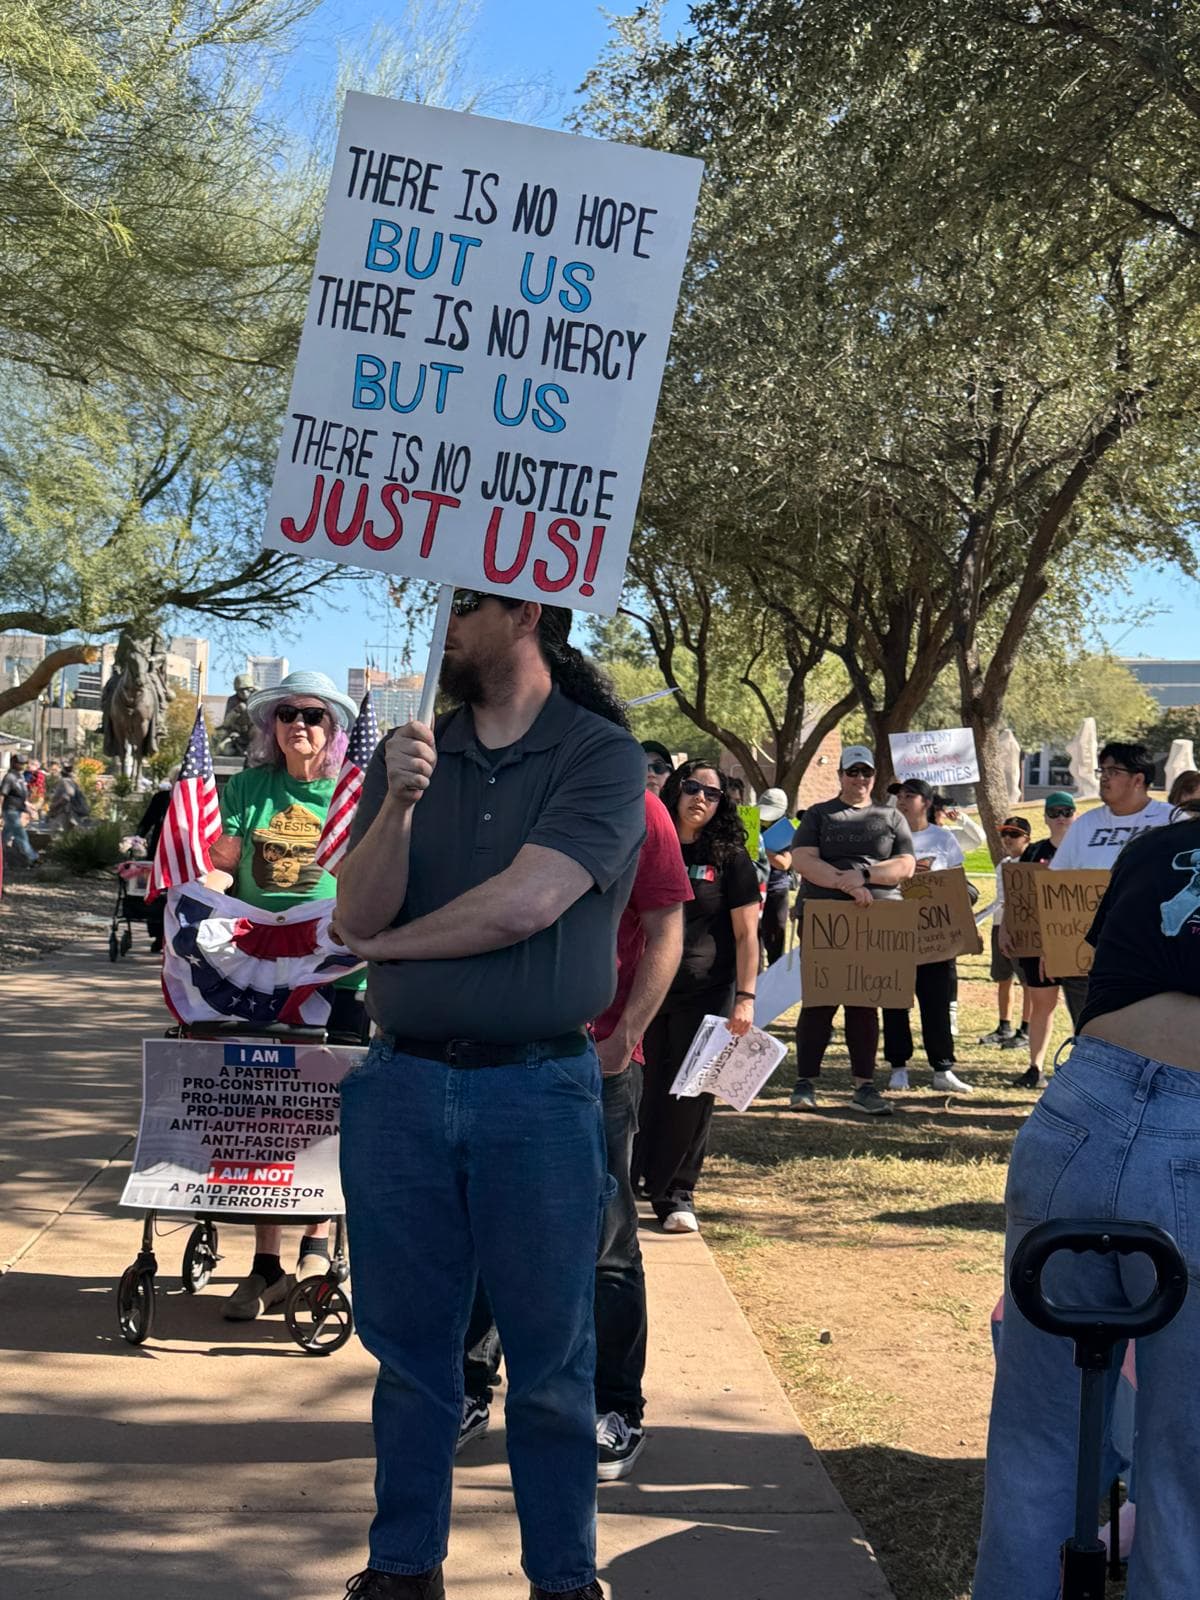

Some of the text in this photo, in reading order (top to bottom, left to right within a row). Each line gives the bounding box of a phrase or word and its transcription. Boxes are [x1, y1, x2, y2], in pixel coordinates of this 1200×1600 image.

[347, 146, 658, 259] THERE IS NO HOPE
[365, 218, 595, 313] BUT US
[317, 275, 647, 381] THERE IS NO MERCY
[352, 354, 569, 433] BUT US
[291, 413, 617, 520] THERE IS NO JUSTICE
[280, 474, 606, 597] JUST US!
[274, 820, 321, 833] RESIST
[812, 913, 915, 953] NO Human
[814, 961, 902, 1002] is Illegal.
[239, 1049, 279, 1063] I AM
[219, 1066, 301, 1080] A PATRIOT
[183, 1077, 339, 1094] PRO-CONSTITUTION
[181, 1092, 340, 1109] PRO-HUMAN RIGHTS
[186, 1105, 334, 1121] PRO-DUE PROCESS
[201, 1135, 311, 1149] ANTI-FASCIST
[211, 1148, 296, 1162] ANTI-KING
[208, 1167, 294, 1182] I AM NOT
[169, 1183, 325, 1198] A PAID PROTESTOR
[191, 1195, 301, 1208] A TERRORIST
